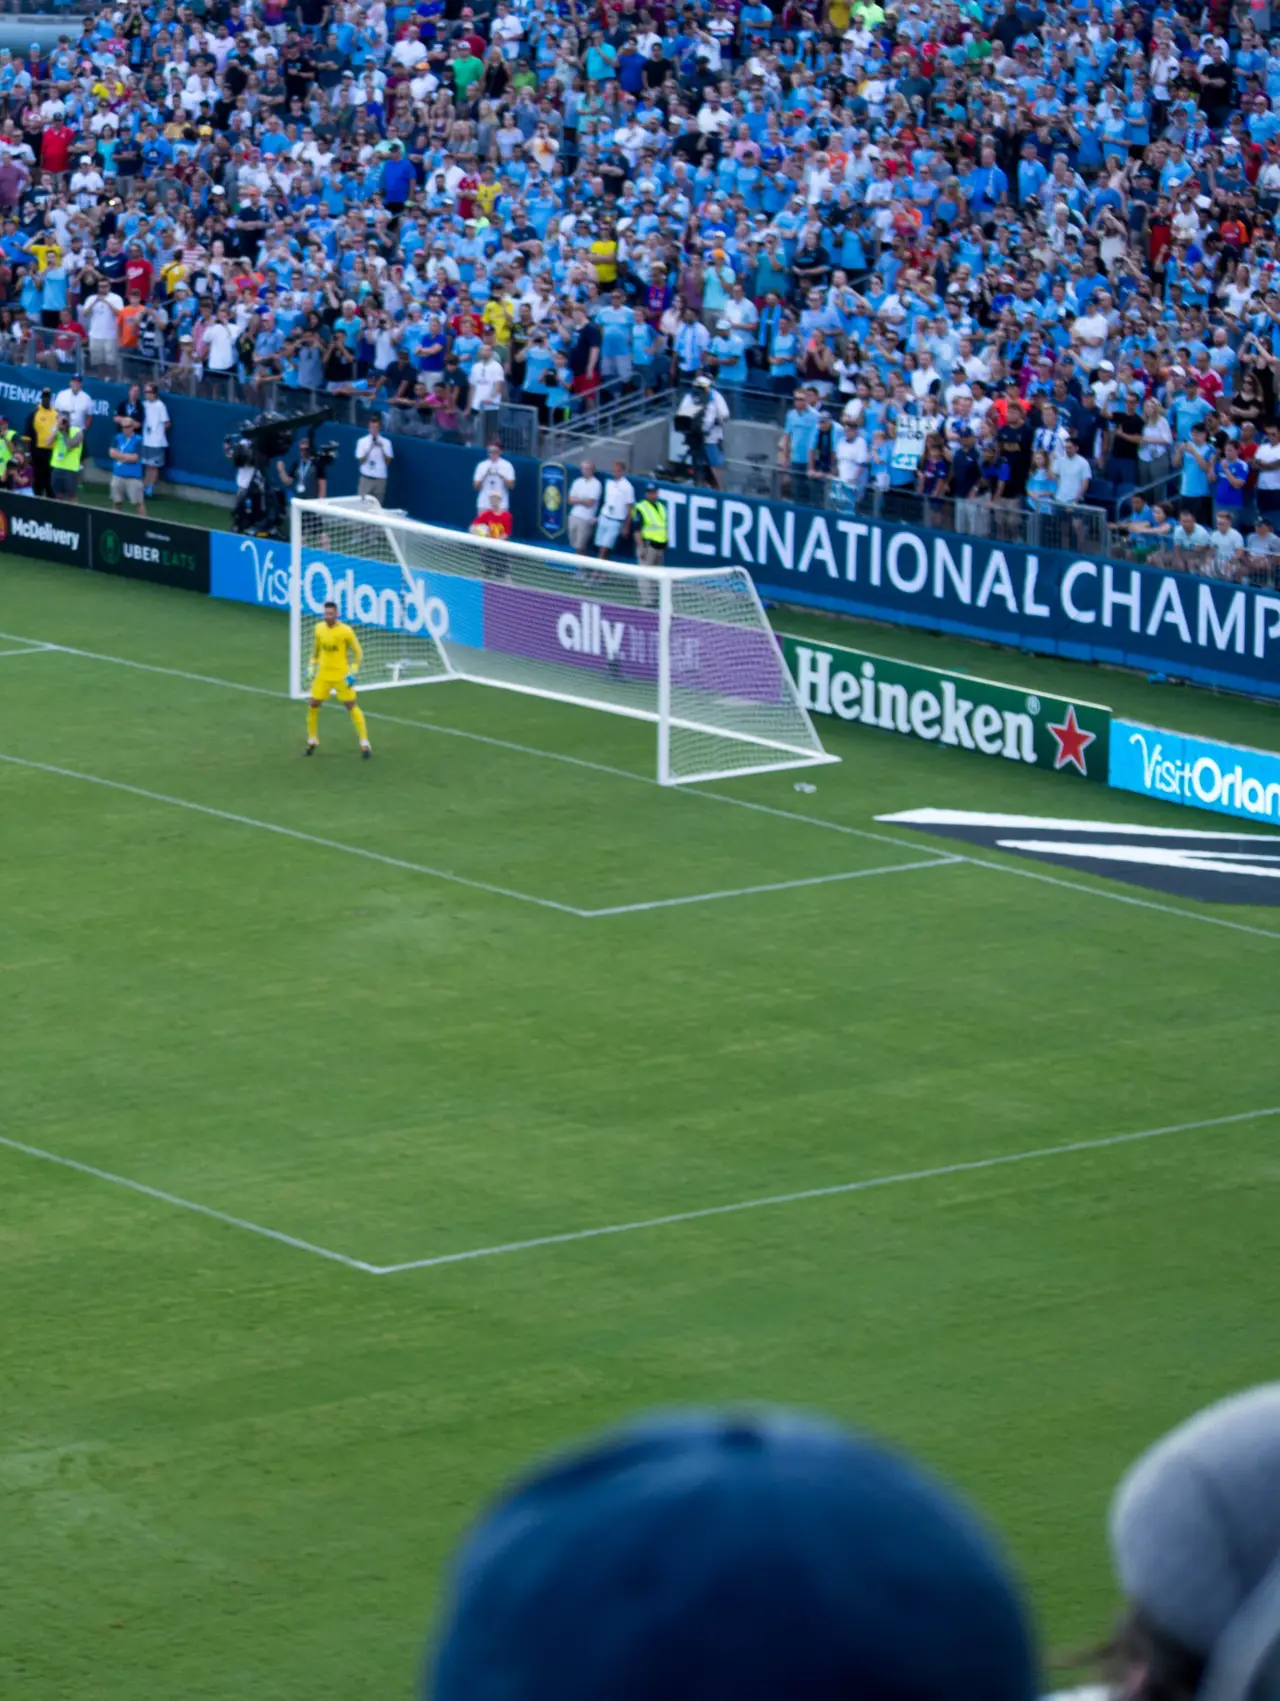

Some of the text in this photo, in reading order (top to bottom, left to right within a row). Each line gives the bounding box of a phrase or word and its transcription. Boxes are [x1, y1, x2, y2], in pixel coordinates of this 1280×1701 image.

[11, 516, 80, 551] McDelivery
[122, 542, 196, 571] UBER EATS
[658, 488, 1280, 659] TERNATIONAL CHAMP
[557, 602, 625, 661] ally
[795, 646, 1038, 763] Heineken
